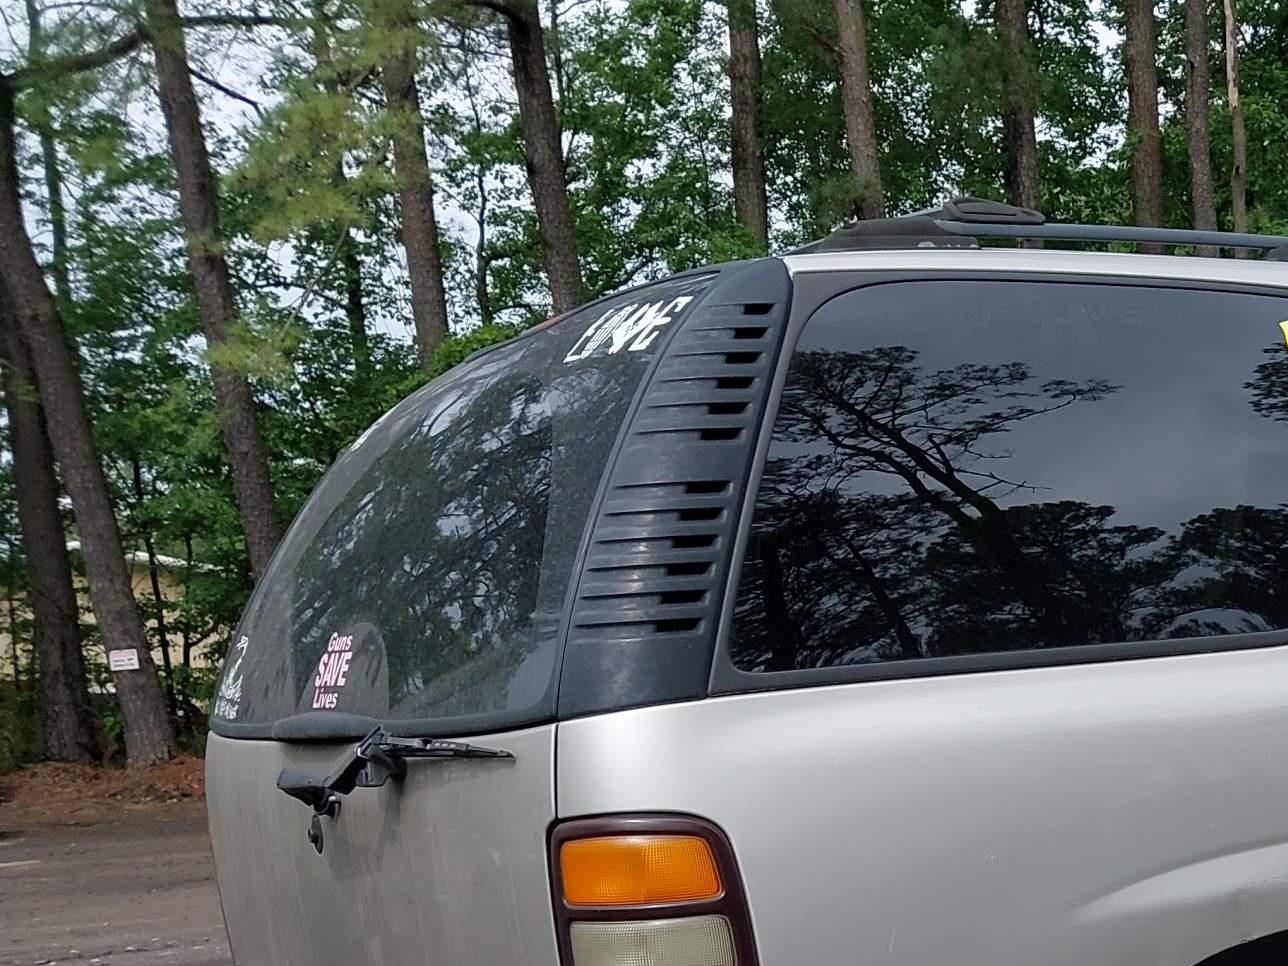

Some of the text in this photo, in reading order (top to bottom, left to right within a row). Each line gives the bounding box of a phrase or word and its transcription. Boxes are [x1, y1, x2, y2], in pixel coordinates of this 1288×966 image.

[327, 631, 353, 652] Guns
[314, 651, 353, 688] SAVE
[312, 687, 339, 709] Lives
